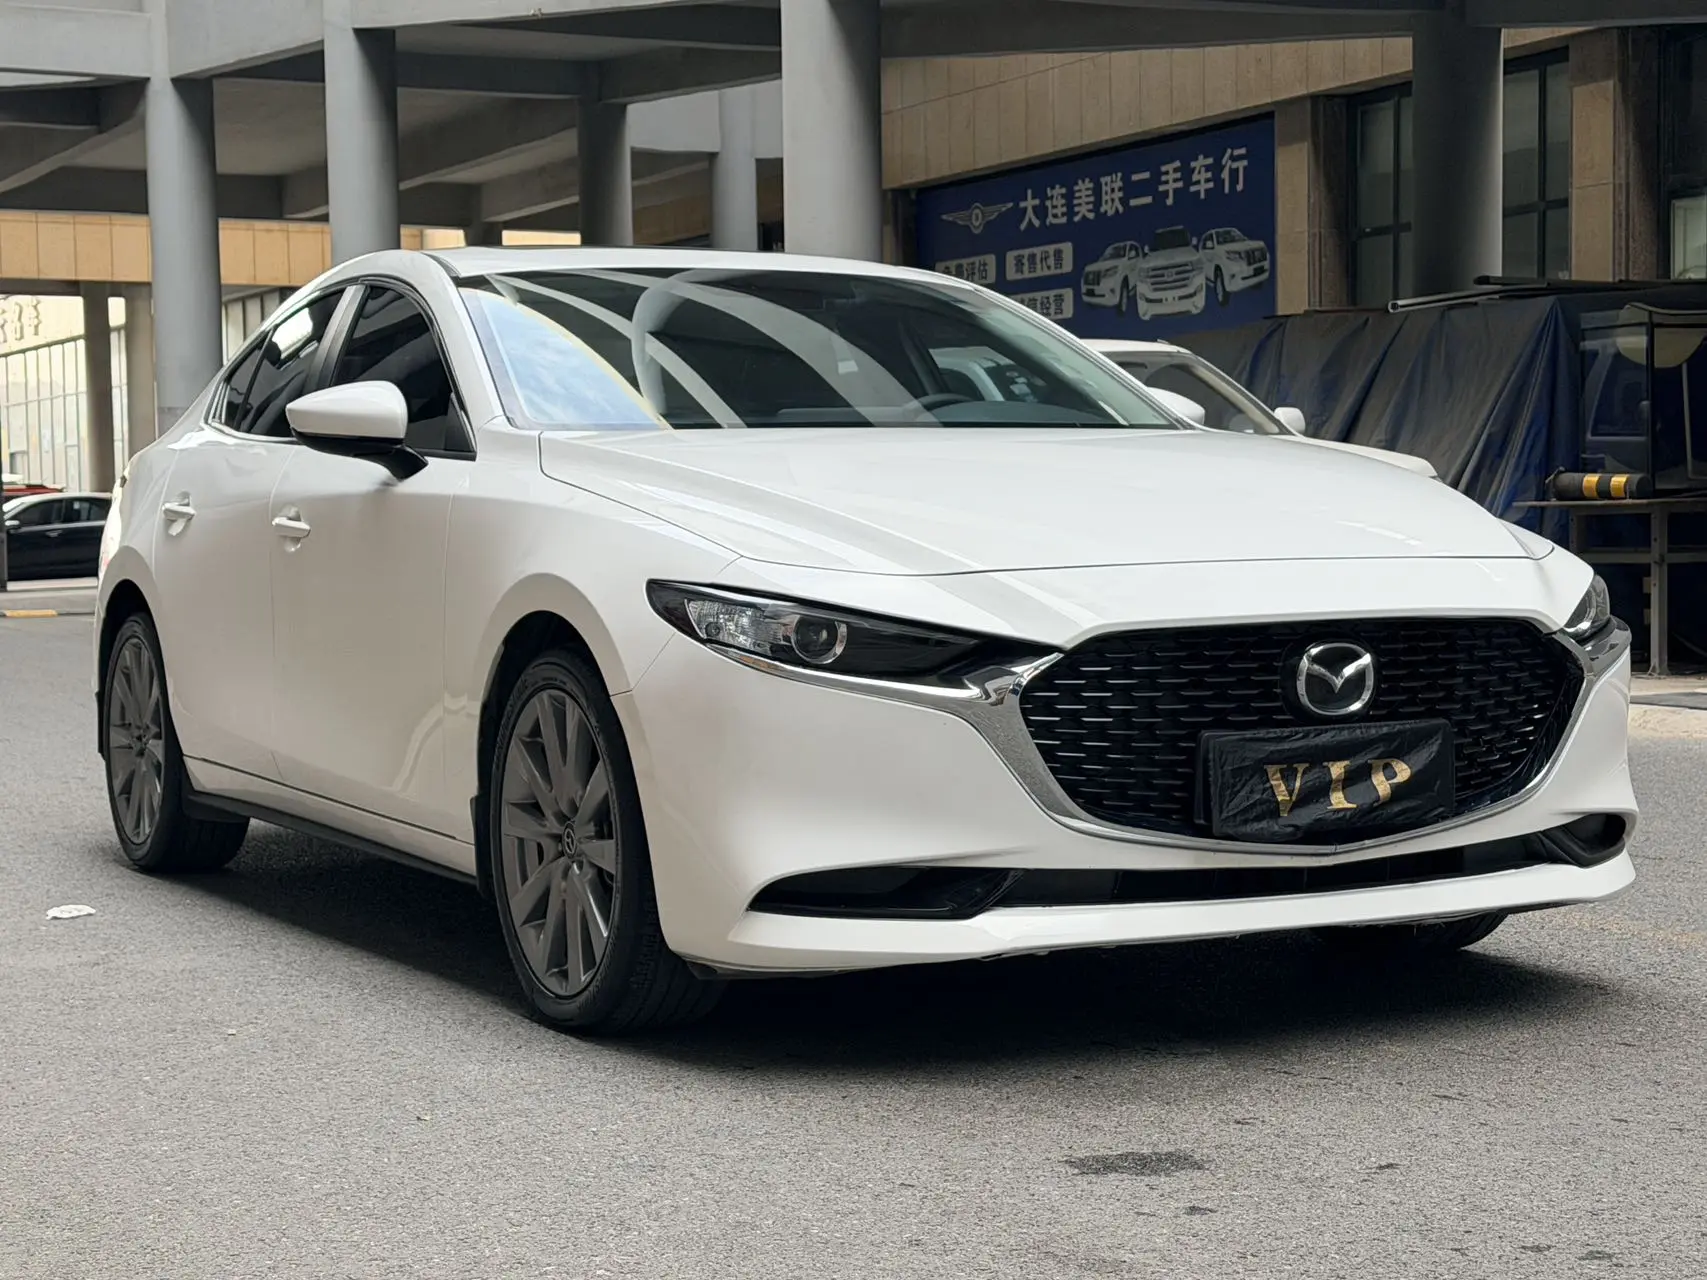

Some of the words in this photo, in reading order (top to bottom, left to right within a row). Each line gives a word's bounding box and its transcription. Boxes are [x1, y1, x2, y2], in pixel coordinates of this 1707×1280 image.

[1019, 147, 1248, 231] 大连美联二手车行
[1014, 248, 1064, 275] 寄售代售
[1020, 293, 1065, 317] 信经营
[1264, 758, 1411, 816] VIP
